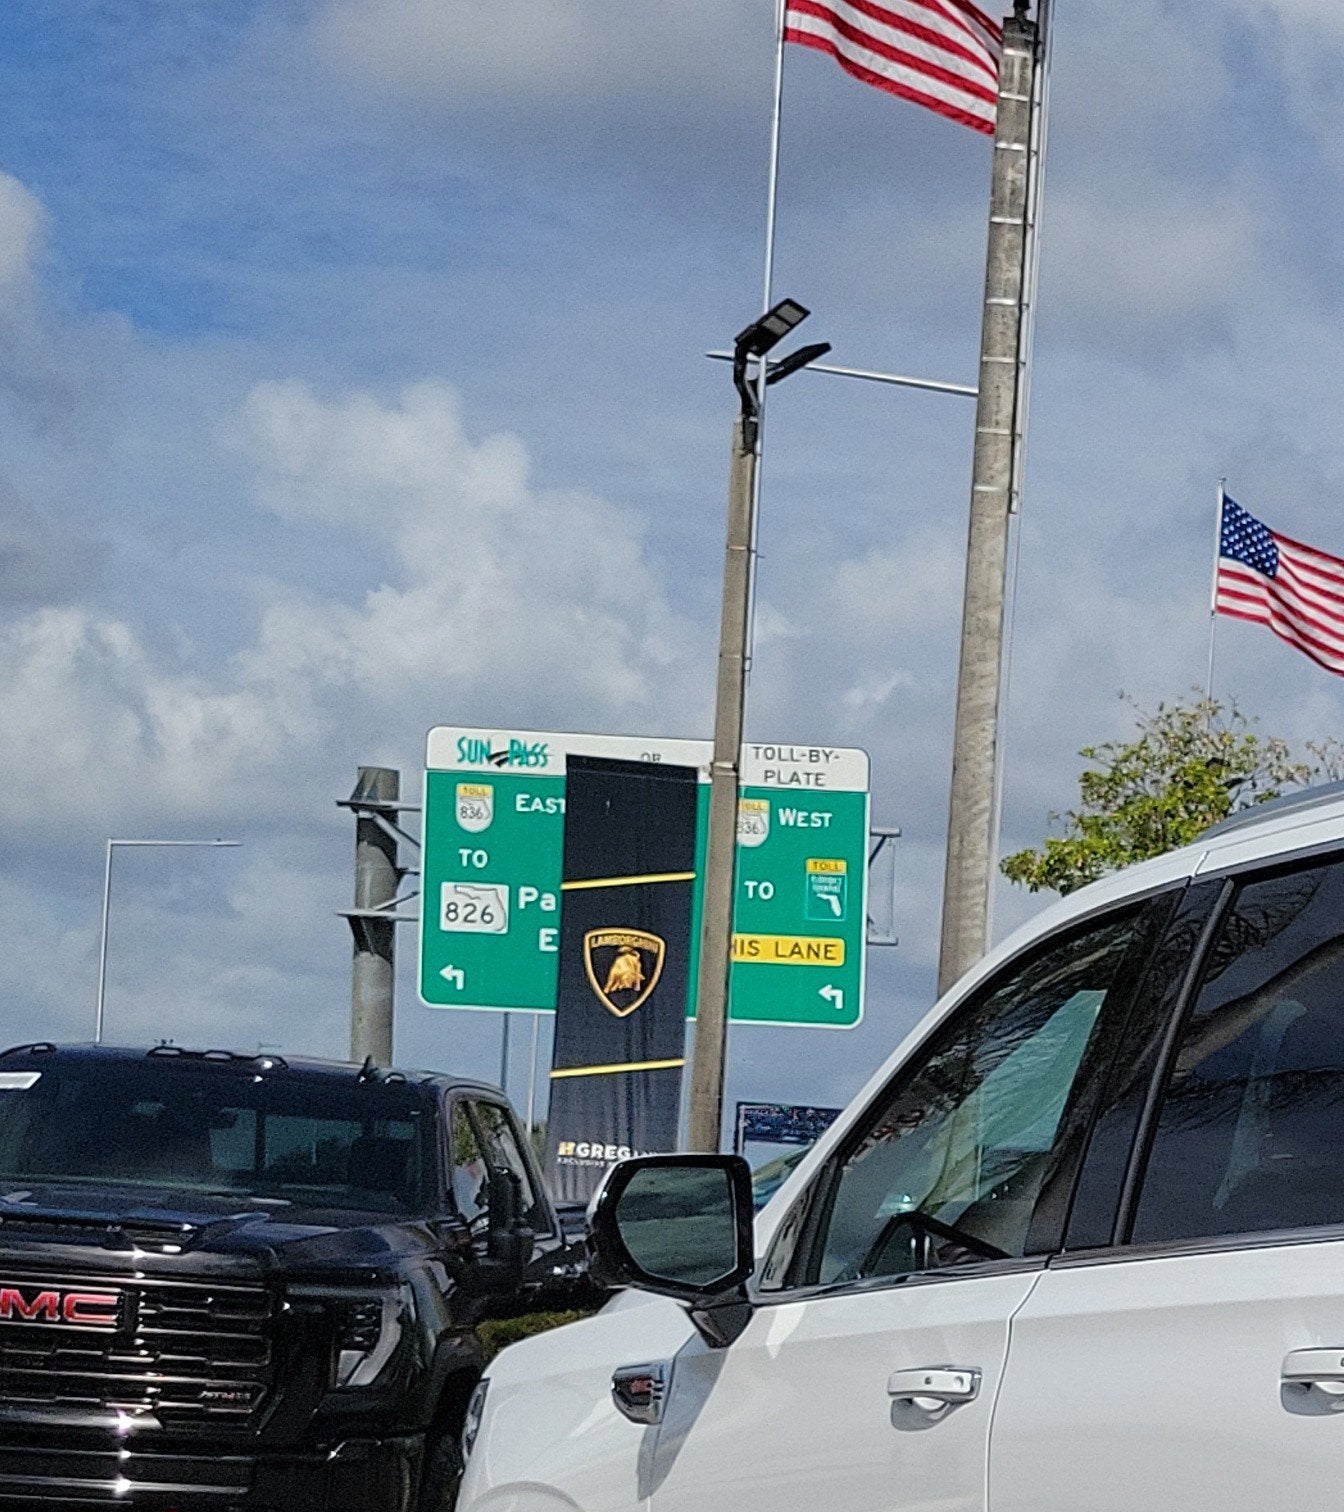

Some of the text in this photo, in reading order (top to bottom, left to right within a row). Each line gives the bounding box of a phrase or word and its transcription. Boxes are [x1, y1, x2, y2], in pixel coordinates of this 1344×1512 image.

[752, 746, 840, 763] TOLL-BY-
[763, 770, 826, 786] PLATE
[460, 806, 484, 819] 836
[778, 808, 833, 828] WEST
[458, 848, 488, 868] TO
[813, 861, 841, 872] TOLL
[743, 880, 775, 900] TO
[445, 901, 495, 924] 826
[775, 940, 837, 961] LANE
